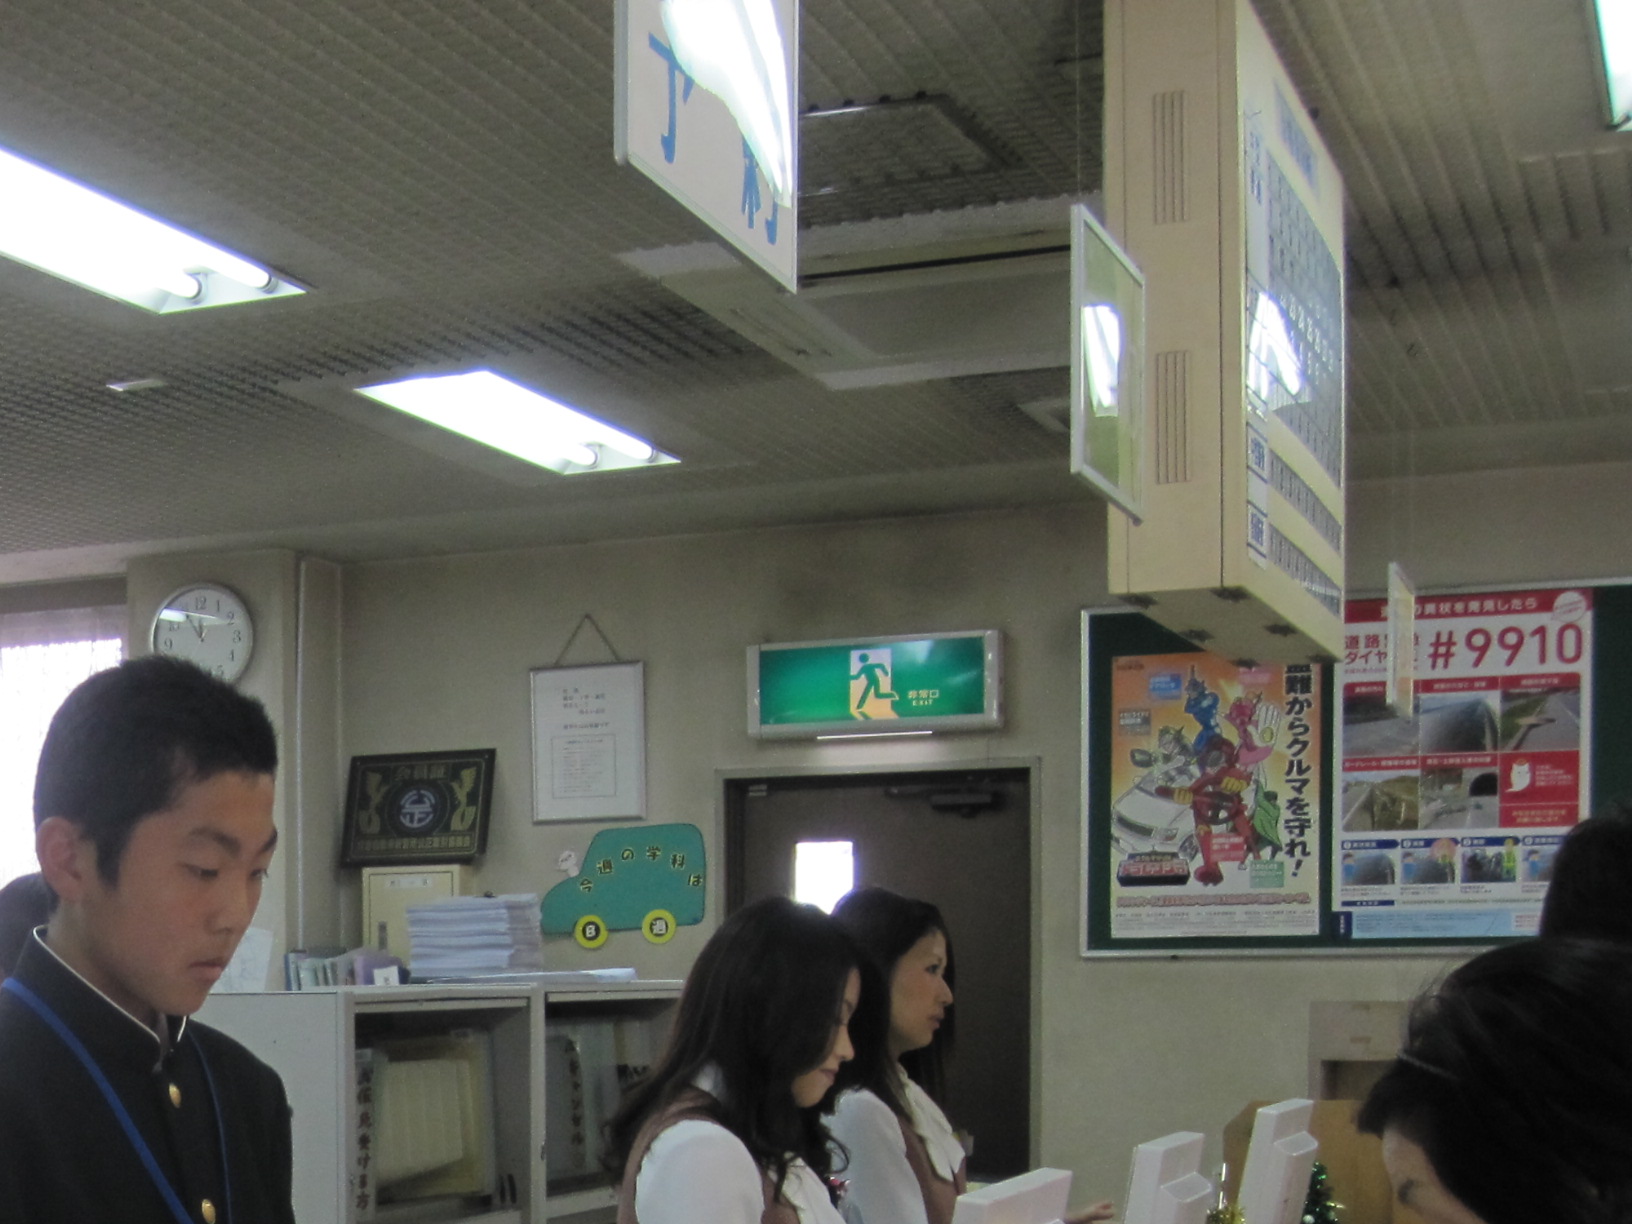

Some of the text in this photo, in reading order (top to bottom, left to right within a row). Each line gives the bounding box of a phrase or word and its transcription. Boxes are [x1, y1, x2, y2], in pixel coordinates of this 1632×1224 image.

[1428, 623, 1583, 671] #9910
[909, 689, 939, 699] 非常口
[579, 846, 703, 892] 今週の学科は
